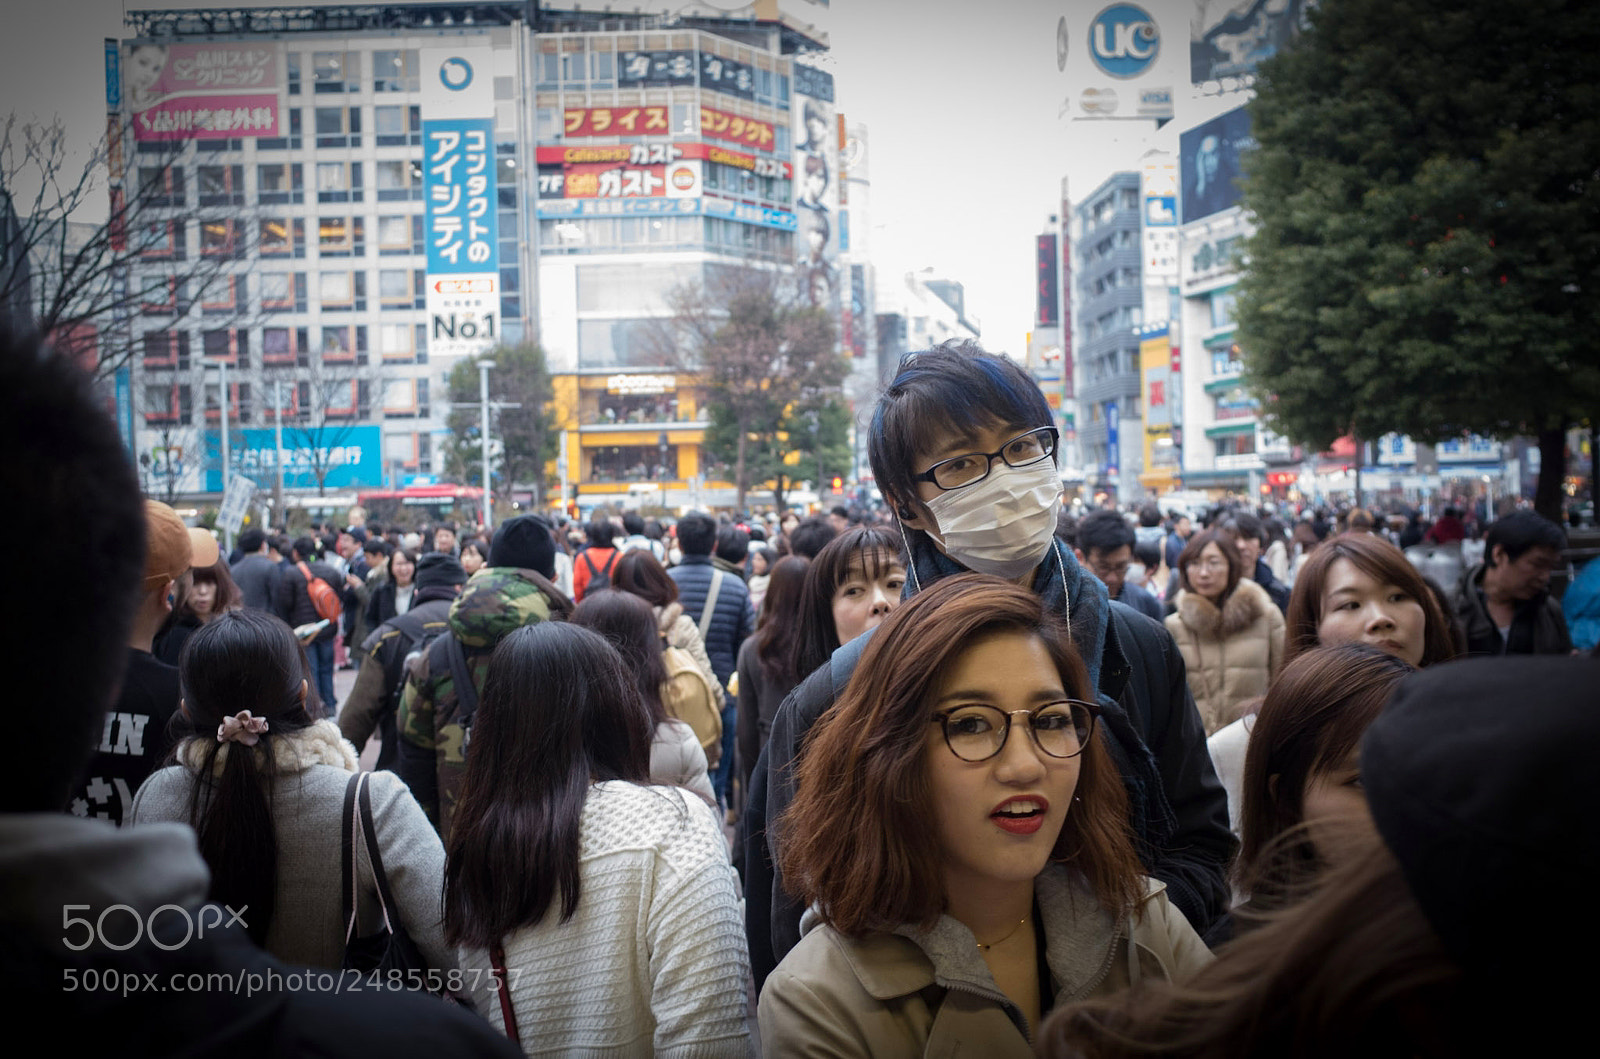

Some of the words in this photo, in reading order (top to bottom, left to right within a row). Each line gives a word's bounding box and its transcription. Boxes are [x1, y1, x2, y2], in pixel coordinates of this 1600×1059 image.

[1093, 23, 1155, 58] UC
[701, 108, 773, 144] コンタクト
[630, 143, 682, 165] ガスト
[430, 131, 463, 264] アイシティ
[465, 130, 490, 263] コンタクトの
[539, 174, 564, 193] 7F
[597, 169, 664, 197] ガスト
[433, 313, 493, 340] No.1
